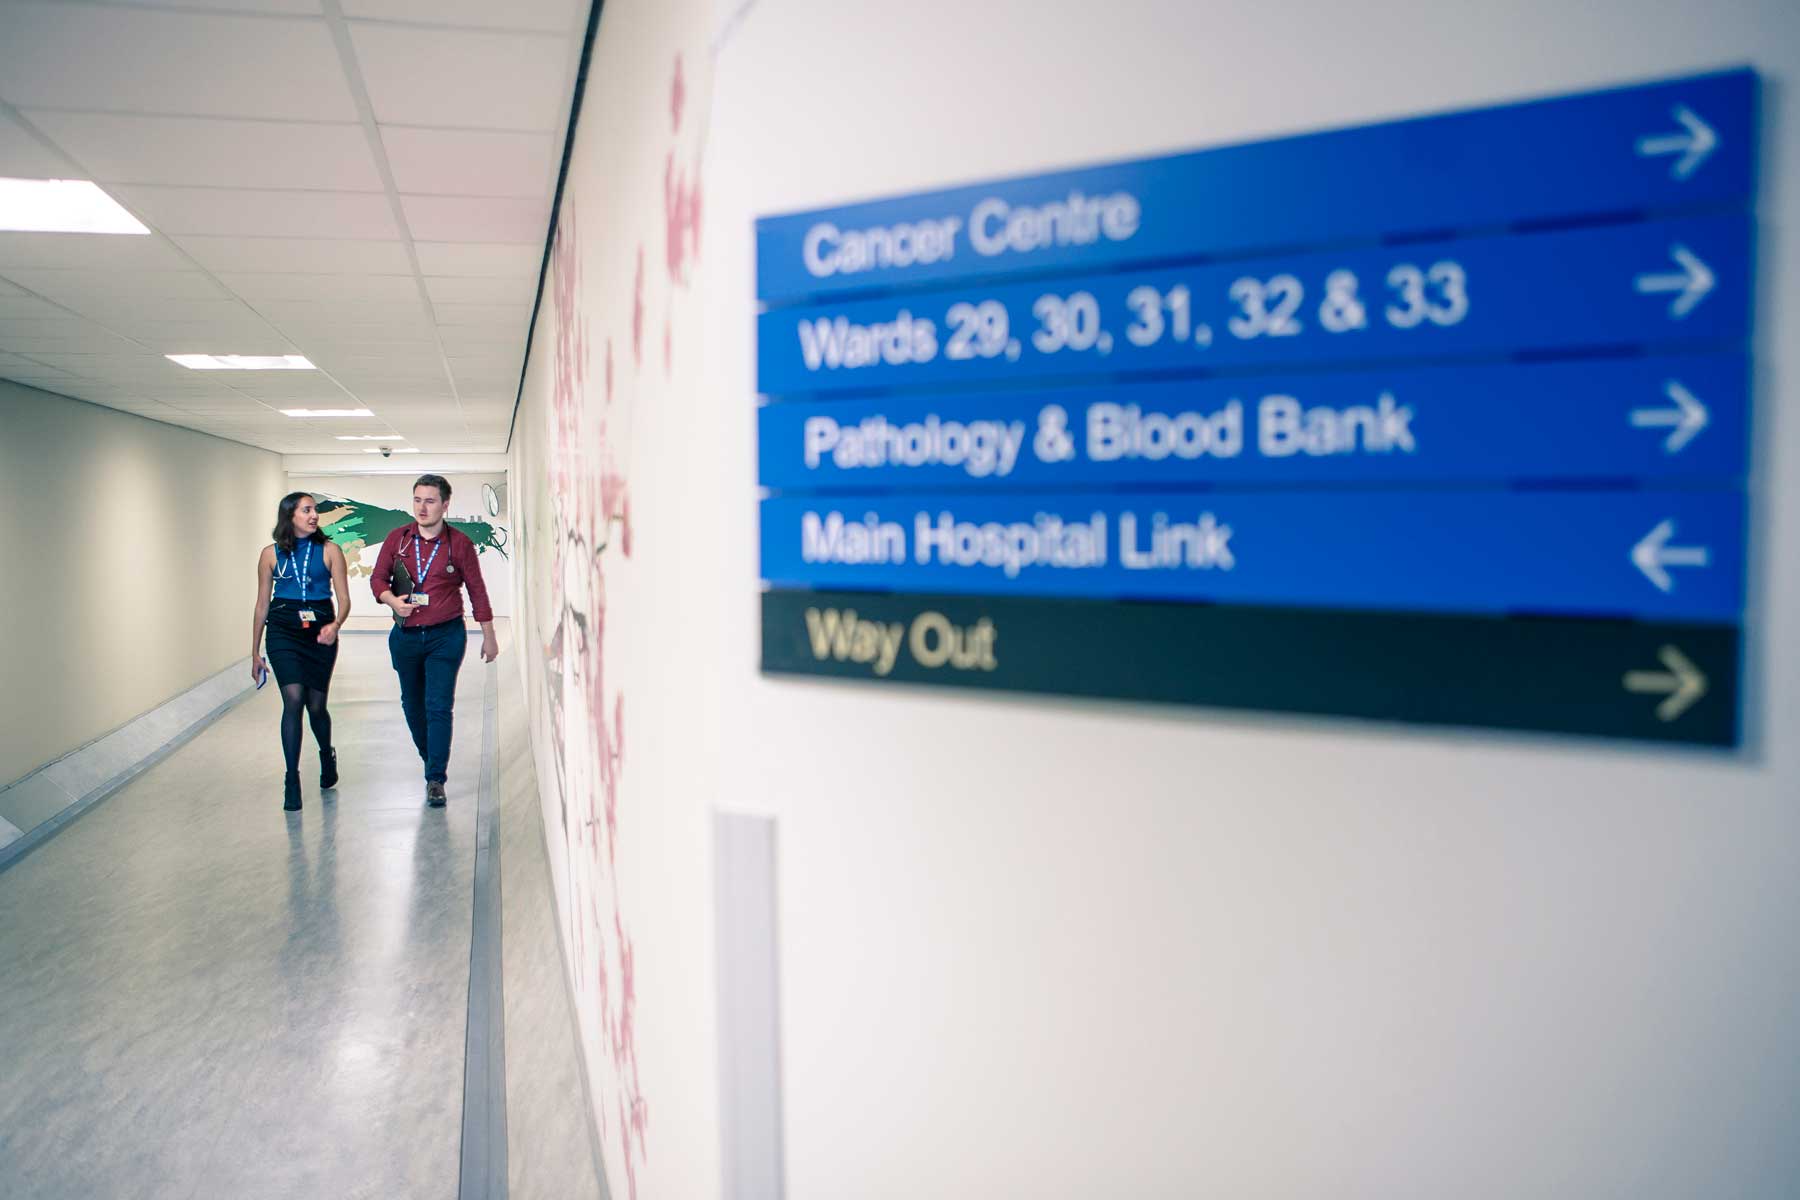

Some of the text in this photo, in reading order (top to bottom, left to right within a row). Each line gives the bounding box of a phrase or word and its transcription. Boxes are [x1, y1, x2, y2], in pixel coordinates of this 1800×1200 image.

[804, 192, 1140, 277] Cancer Centre
[799, 260, 1469, 370] Wards 29, 30, 31, 32 & 33
[804, 391, 1416, 476] Pathology & Blood Bank
[801, 510, 1235, 579] Main Hospital Link
[806, 607, 997, 676] Way Out
